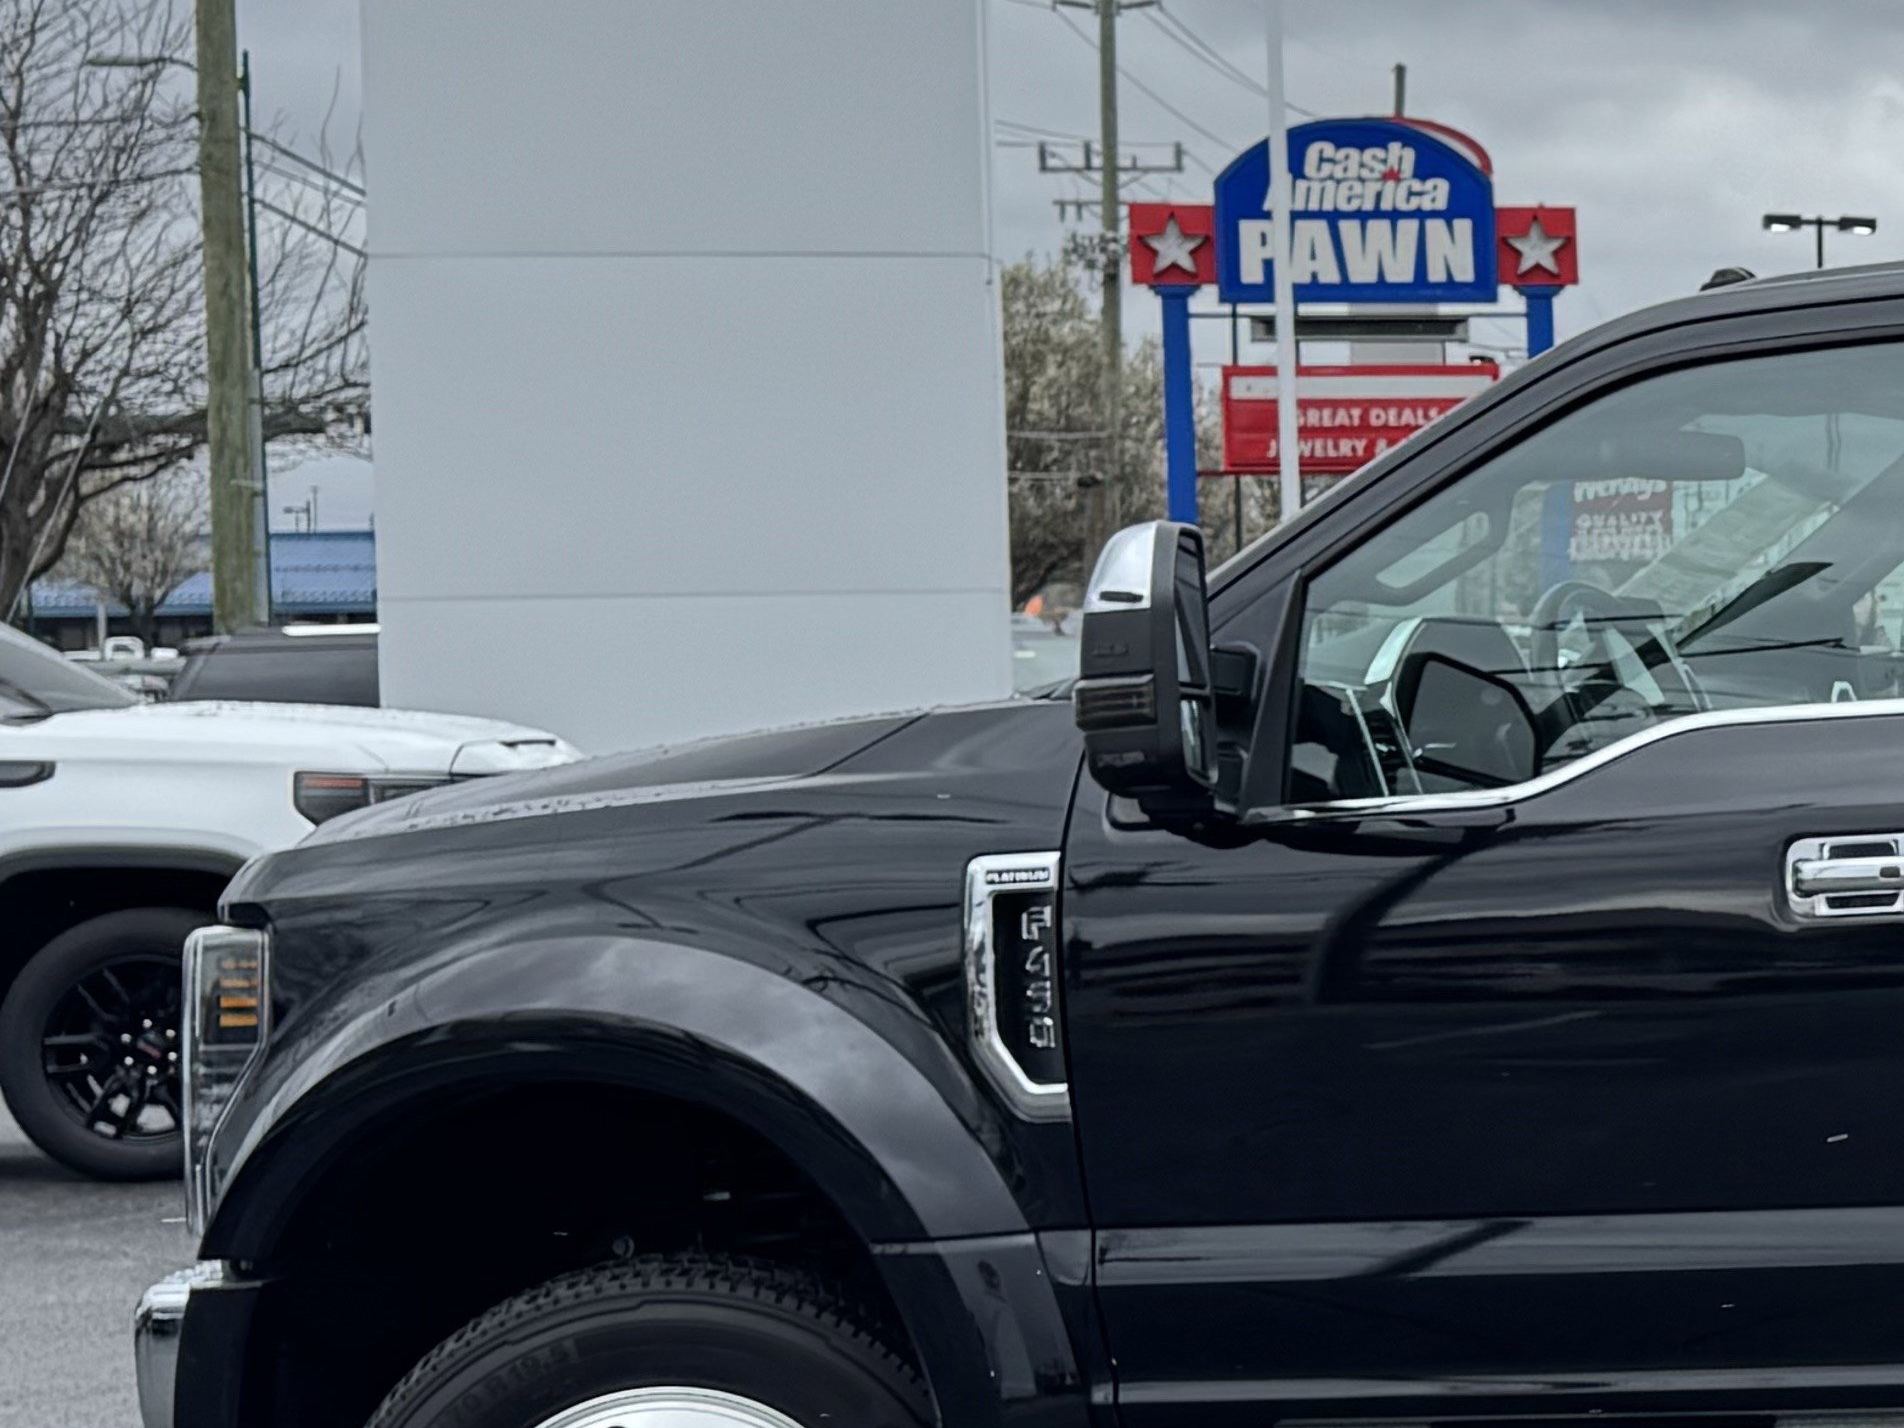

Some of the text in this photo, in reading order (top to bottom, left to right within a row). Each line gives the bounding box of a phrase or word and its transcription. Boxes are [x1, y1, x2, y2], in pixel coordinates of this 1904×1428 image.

[1304, 140, 1416, 180] Cash
[1238, 218, 1475, 285] PAWN
[1267, 438, 1368, 458] JWELRY
